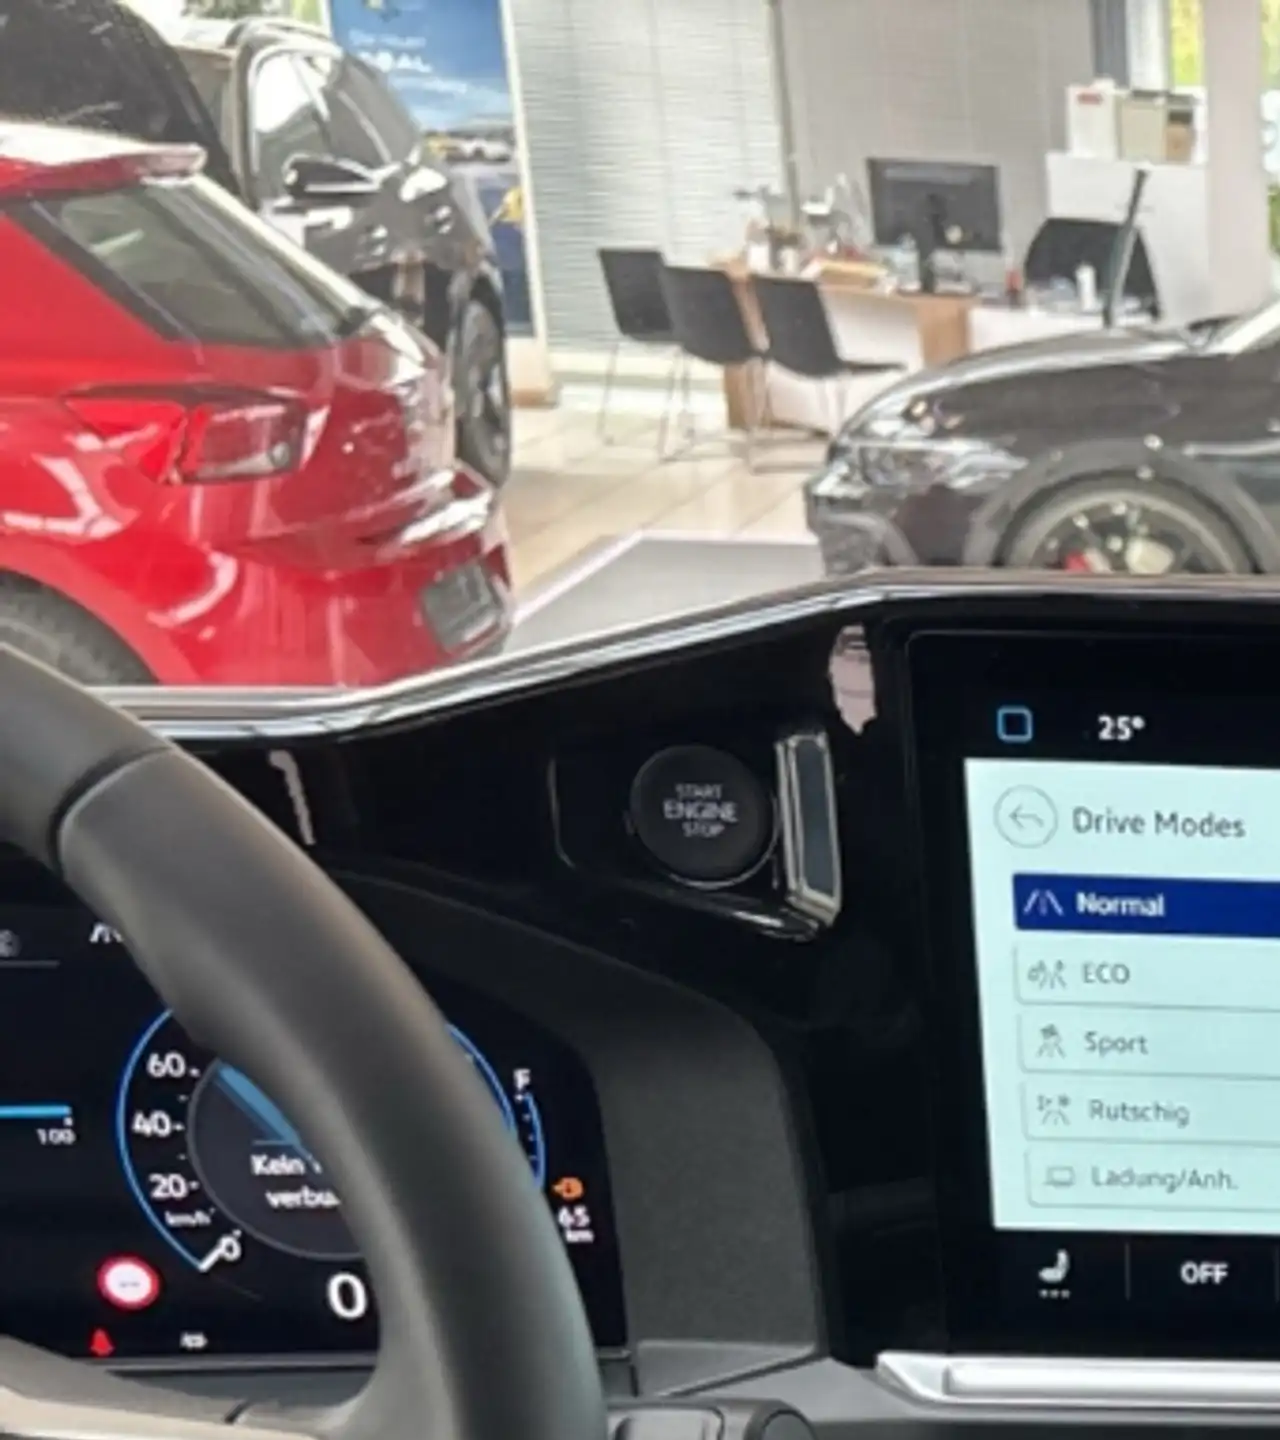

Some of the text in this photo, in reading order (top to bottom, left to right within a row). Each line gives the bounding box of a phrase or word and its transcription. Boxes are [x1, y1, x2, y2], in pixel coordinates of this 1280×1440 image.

[1098, 714, 1145, 741] 25°
[675, 784, 722, 799] START
[663, 799, 738, 822] ENGINE
[1072, 806, 1246, 838] Drive Modes
[683, 822, 725, 838] STOP
[1076, 891, 1165, 917] Normal
[1082, 962, 1131, 985] ECO
[1084, 1030, 1149, 1062] Sport
[147, 1053, 186, 1078] 60
[514, 1068, 531, 1090] F
[132, 1110, 172, 1137] 40
[1089, 1098, 1190, 1129] Rutschig
[251, 1154, 305, 1175] Kein
[150, 1173, 188, 1199] 20
[1091, 1166, 1238, 1194] Ladung/Anh.
[265, 1186, 340, 1208] verbu
[559, 1205, 590, 1227] 65
[566, 1229, 594, 1243] km
[1180, 1261, 1228, 1285] OFF
[327, 1273, 367, 1319] 0
